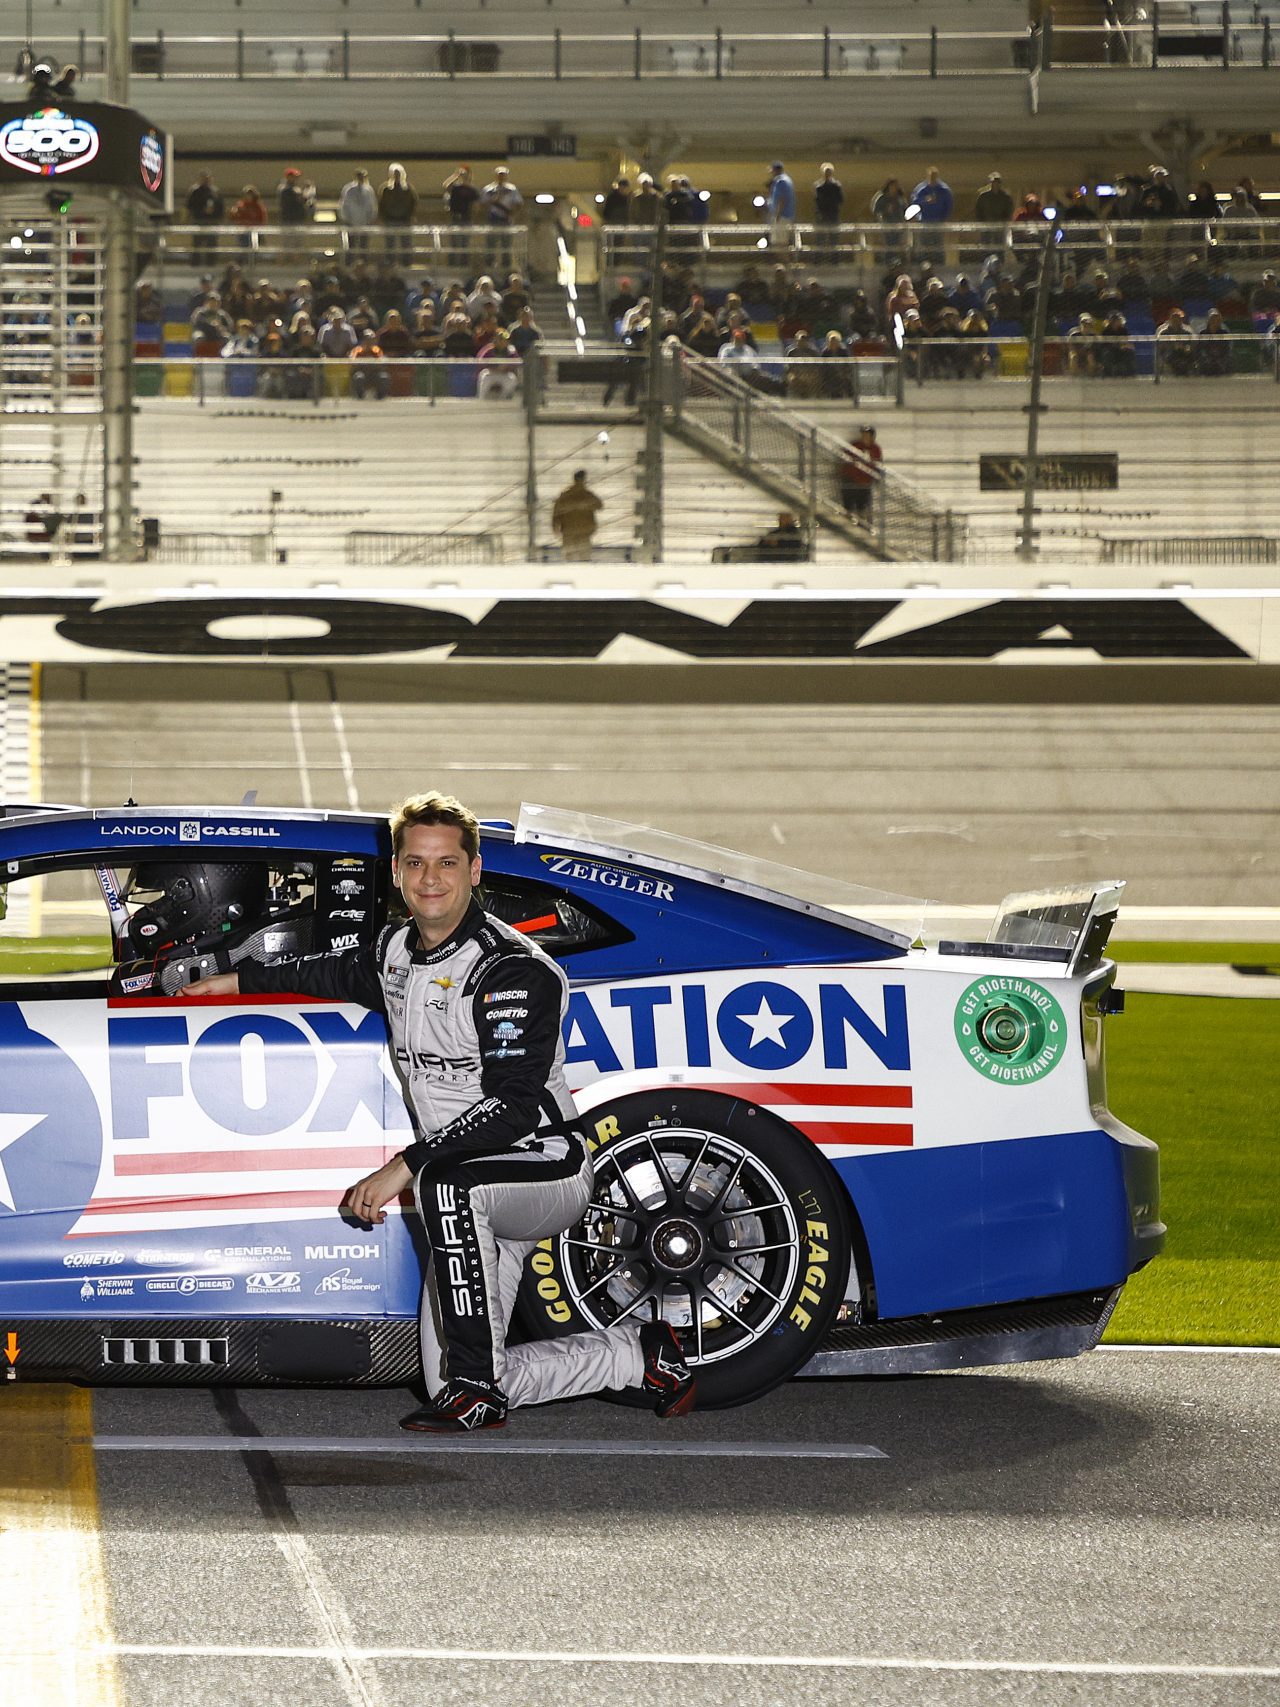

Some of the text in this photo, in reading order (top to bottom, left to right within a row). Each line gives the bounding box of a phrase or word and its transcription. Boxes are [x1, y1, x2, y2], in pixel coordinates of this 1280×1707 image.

[5, 129, 91, 153] 500
[100, 825, 281, 837] LANDON CASSILL
[590, 862, 640, 877] AUTO GROUP
[548, 856, 675, 902] ZEIGLER
[106, 889, 121, 912] FOX
[330, 932, 360, 949] WIX
[124, 980, 138, 990] FOX
[495, 990, 529, 1001] NASCAR
[962, 978, 1053, 1016] GET BIOETHANOL
[485, 1007, 529, 1020] COMETIC
[563, 981, 912, 1073] ATION
[969, 1043, 1058, 1081] GET BIOETHANOL
[107, 1011, 420, 1140] FOX
[224, 1246, 291, 1256] GENERAL
[304, 1245, 380, 1260] MUTOH
[434, 1183, 473, 1317] SPIRE
[458, 1187, 484, 1316] MOTORSPORTS
[62, 1250, 126, 1267] COMETIC
[97, 1279, 134, 1288] SHERWIN
[341, 1277, 363, 1285] Royal
[531, 1237, 572, 1323] GOO
[789, 1219, 830, 1332] EAGLE
[180, 1278, 196, 1292] B
[199, 1280, 232, 1289] DIECAST
[246, 1285, 301, 1294] MECHANIX WEAR
[322, 1276, 341, 1292] RS
[341, 1283, 381, 1292] Sovereign
